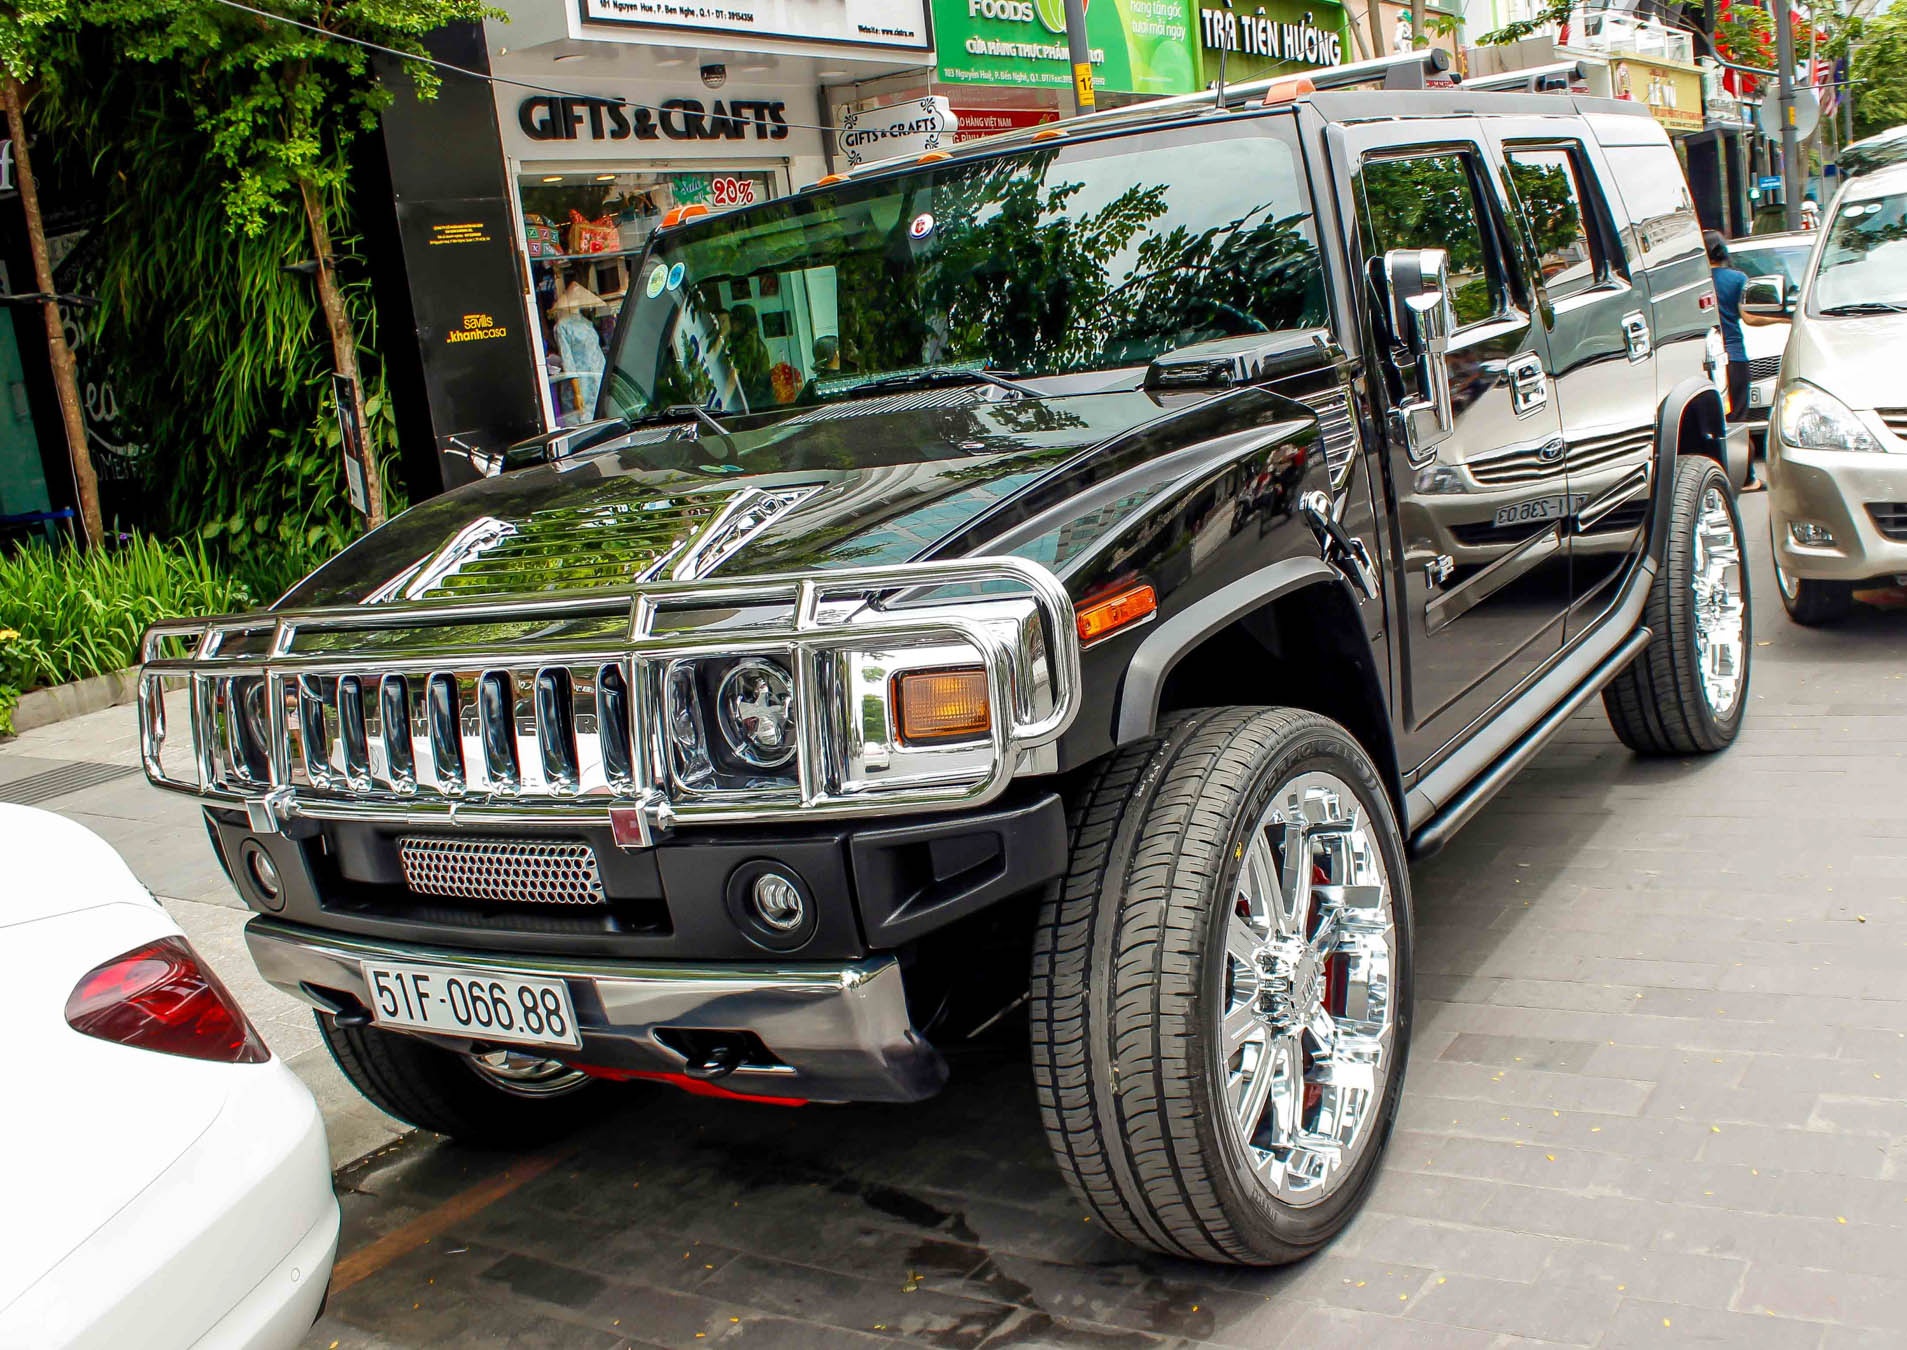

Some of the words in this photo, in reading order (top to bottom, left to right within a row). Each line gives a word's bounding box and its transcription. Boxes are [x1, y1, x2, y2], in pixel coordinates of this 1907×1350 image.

[612, 0, 638, 13] Nguyen
[968, 0, 1035, 23] FOODS
[1239, 6, 1280, 58] TIÊN
[846, 129, 879, 148] GIFTS
[889, 116, 937, 138] CRAFTS
[997, 117, 1012, 128] NAM
[712, 177, 755, 206] 20%
[372, 970, 567, 1038] 51F-066.88
